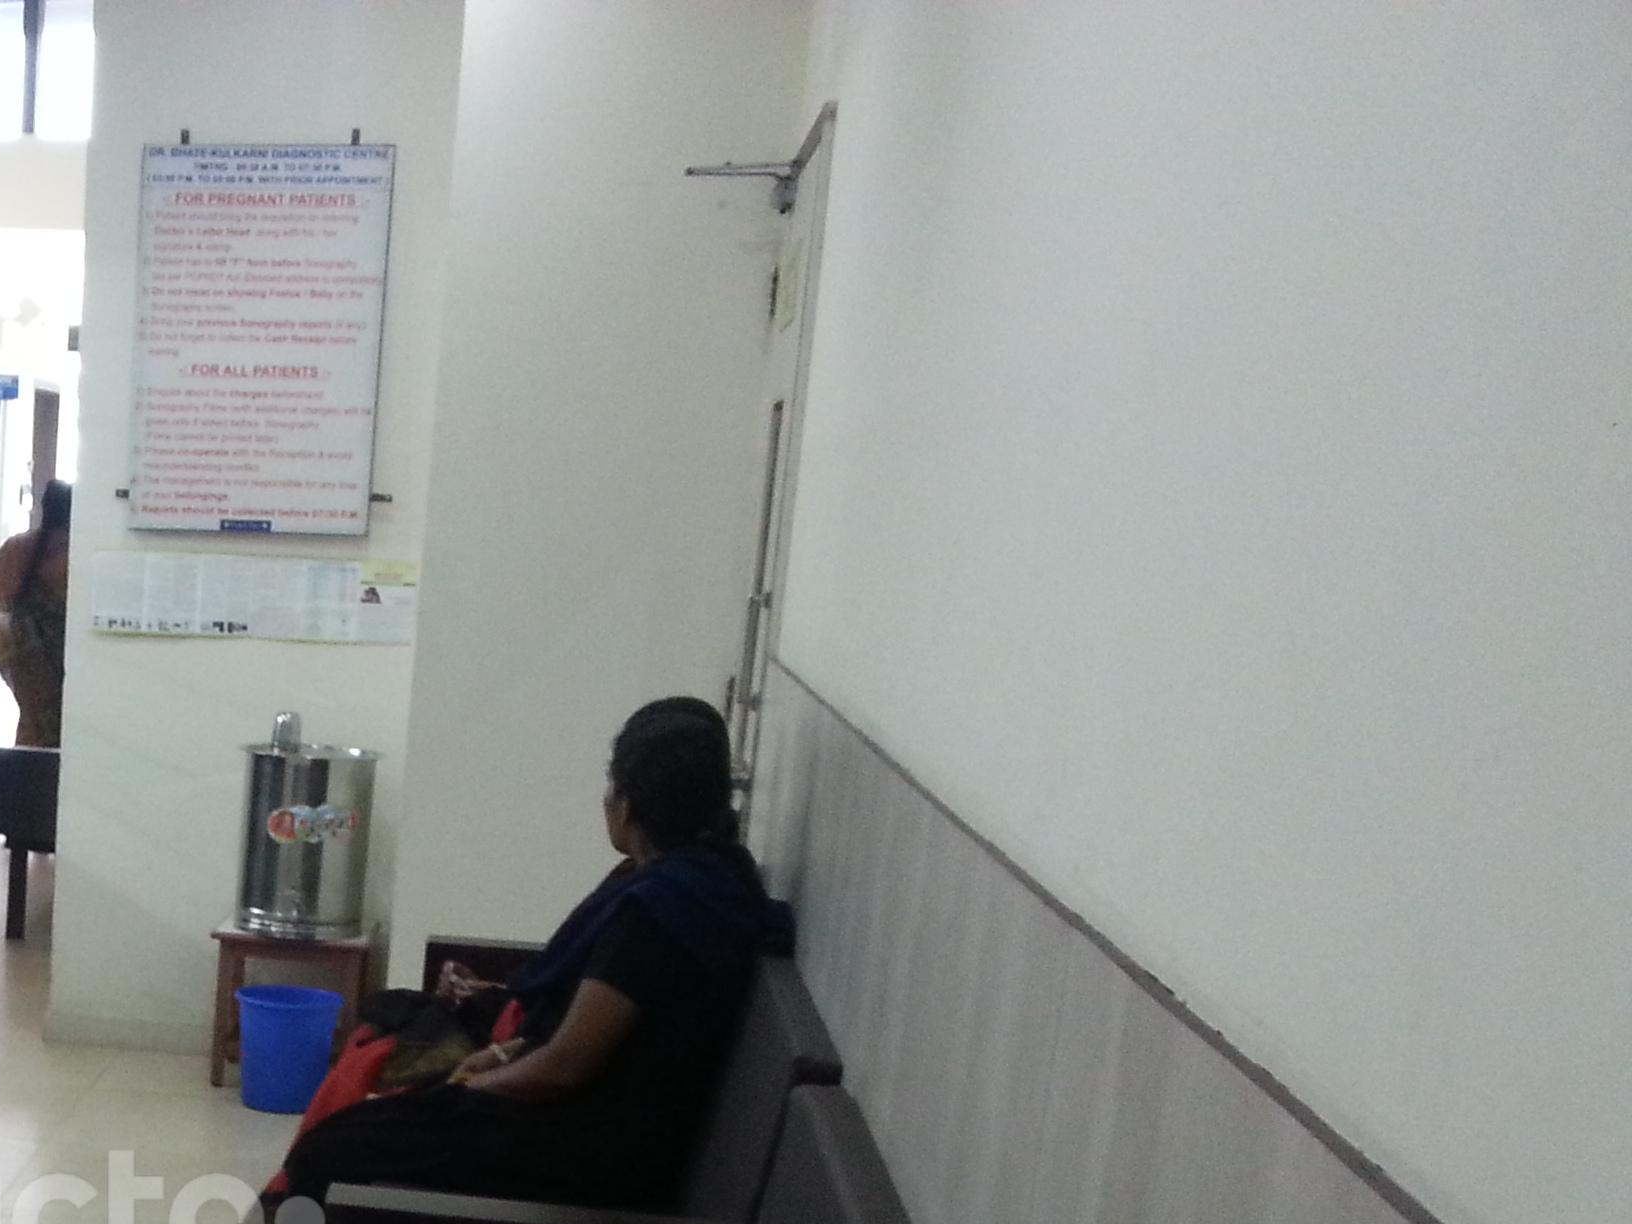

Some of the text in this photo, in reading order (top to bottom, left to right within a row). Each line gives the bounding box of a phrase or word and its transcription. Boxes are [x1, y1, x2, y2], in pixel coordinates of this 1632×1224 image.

[174, 193, 357, 207] FOR PREGNANT PATIENTS
[190, 363, 319, 379] FOR ALL PATIENTS
